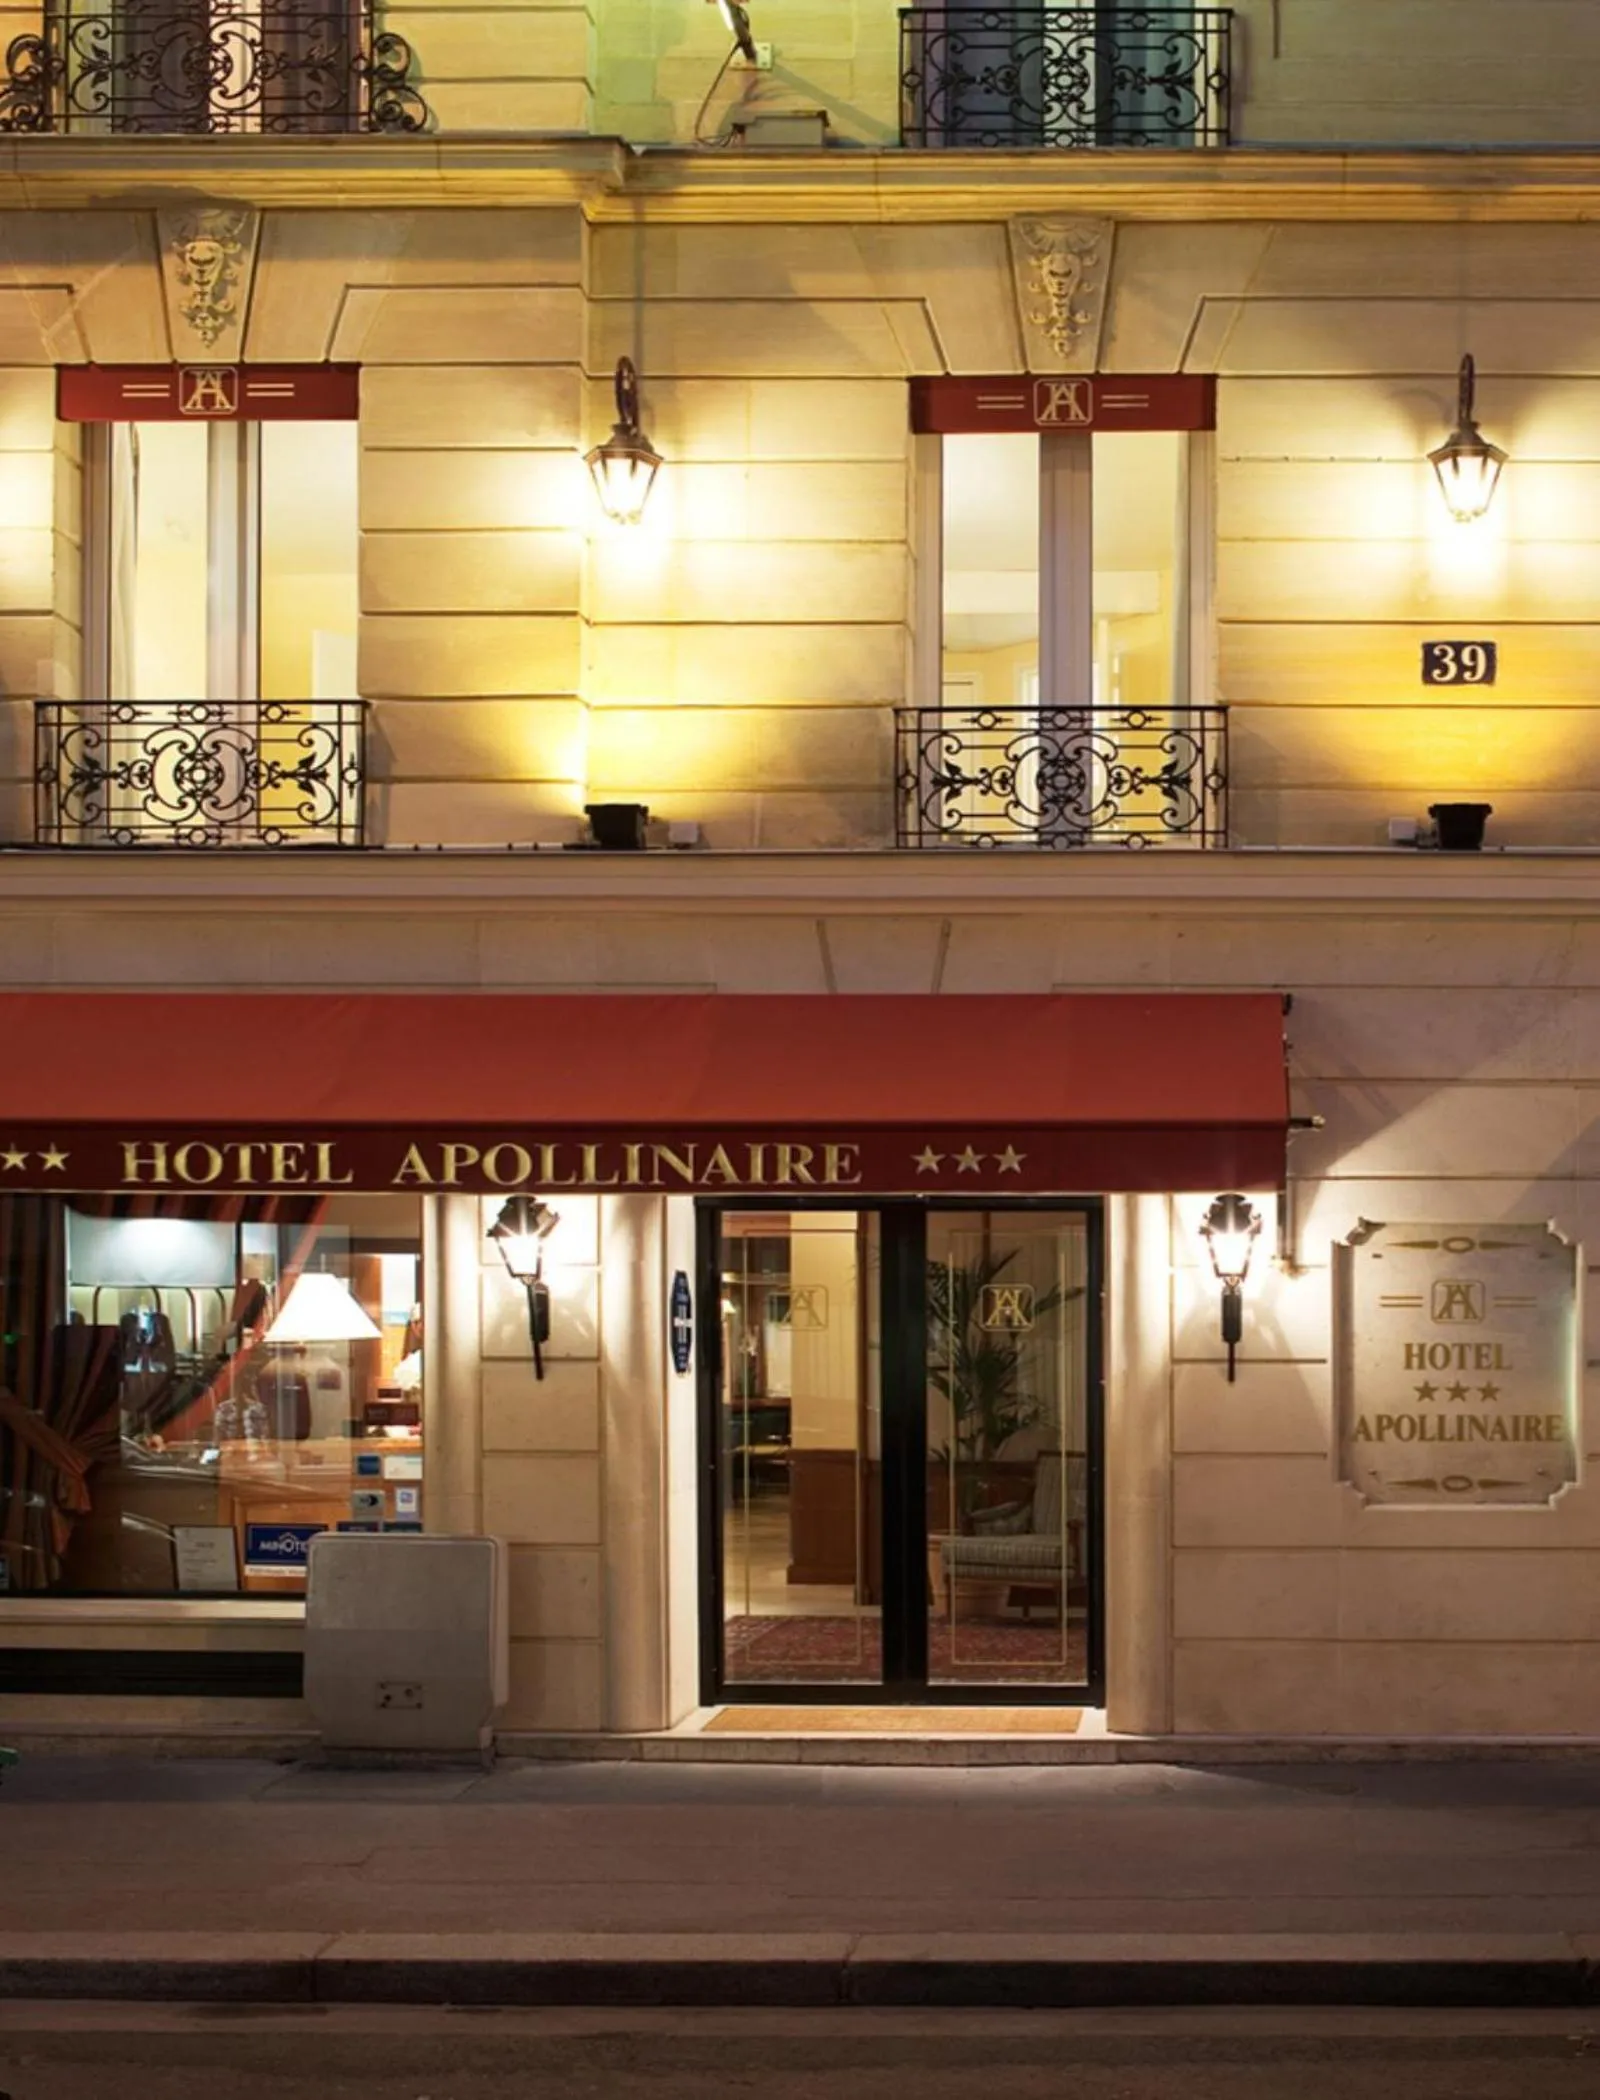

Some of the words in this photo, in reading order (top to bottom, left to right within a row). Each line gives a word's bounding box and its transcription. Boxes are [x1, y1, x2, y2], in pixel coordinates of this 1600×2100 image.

[1431, 643, 1487, 682] 39
[118, 1140, 354, 1184] HOTEL
[390, 1142, 863, 1187] APOLLINAIRE
[1403, 1342, 1514, 1371] HOTEL
[1351, 1413, 1565, 1443] APOLLINAIRE
